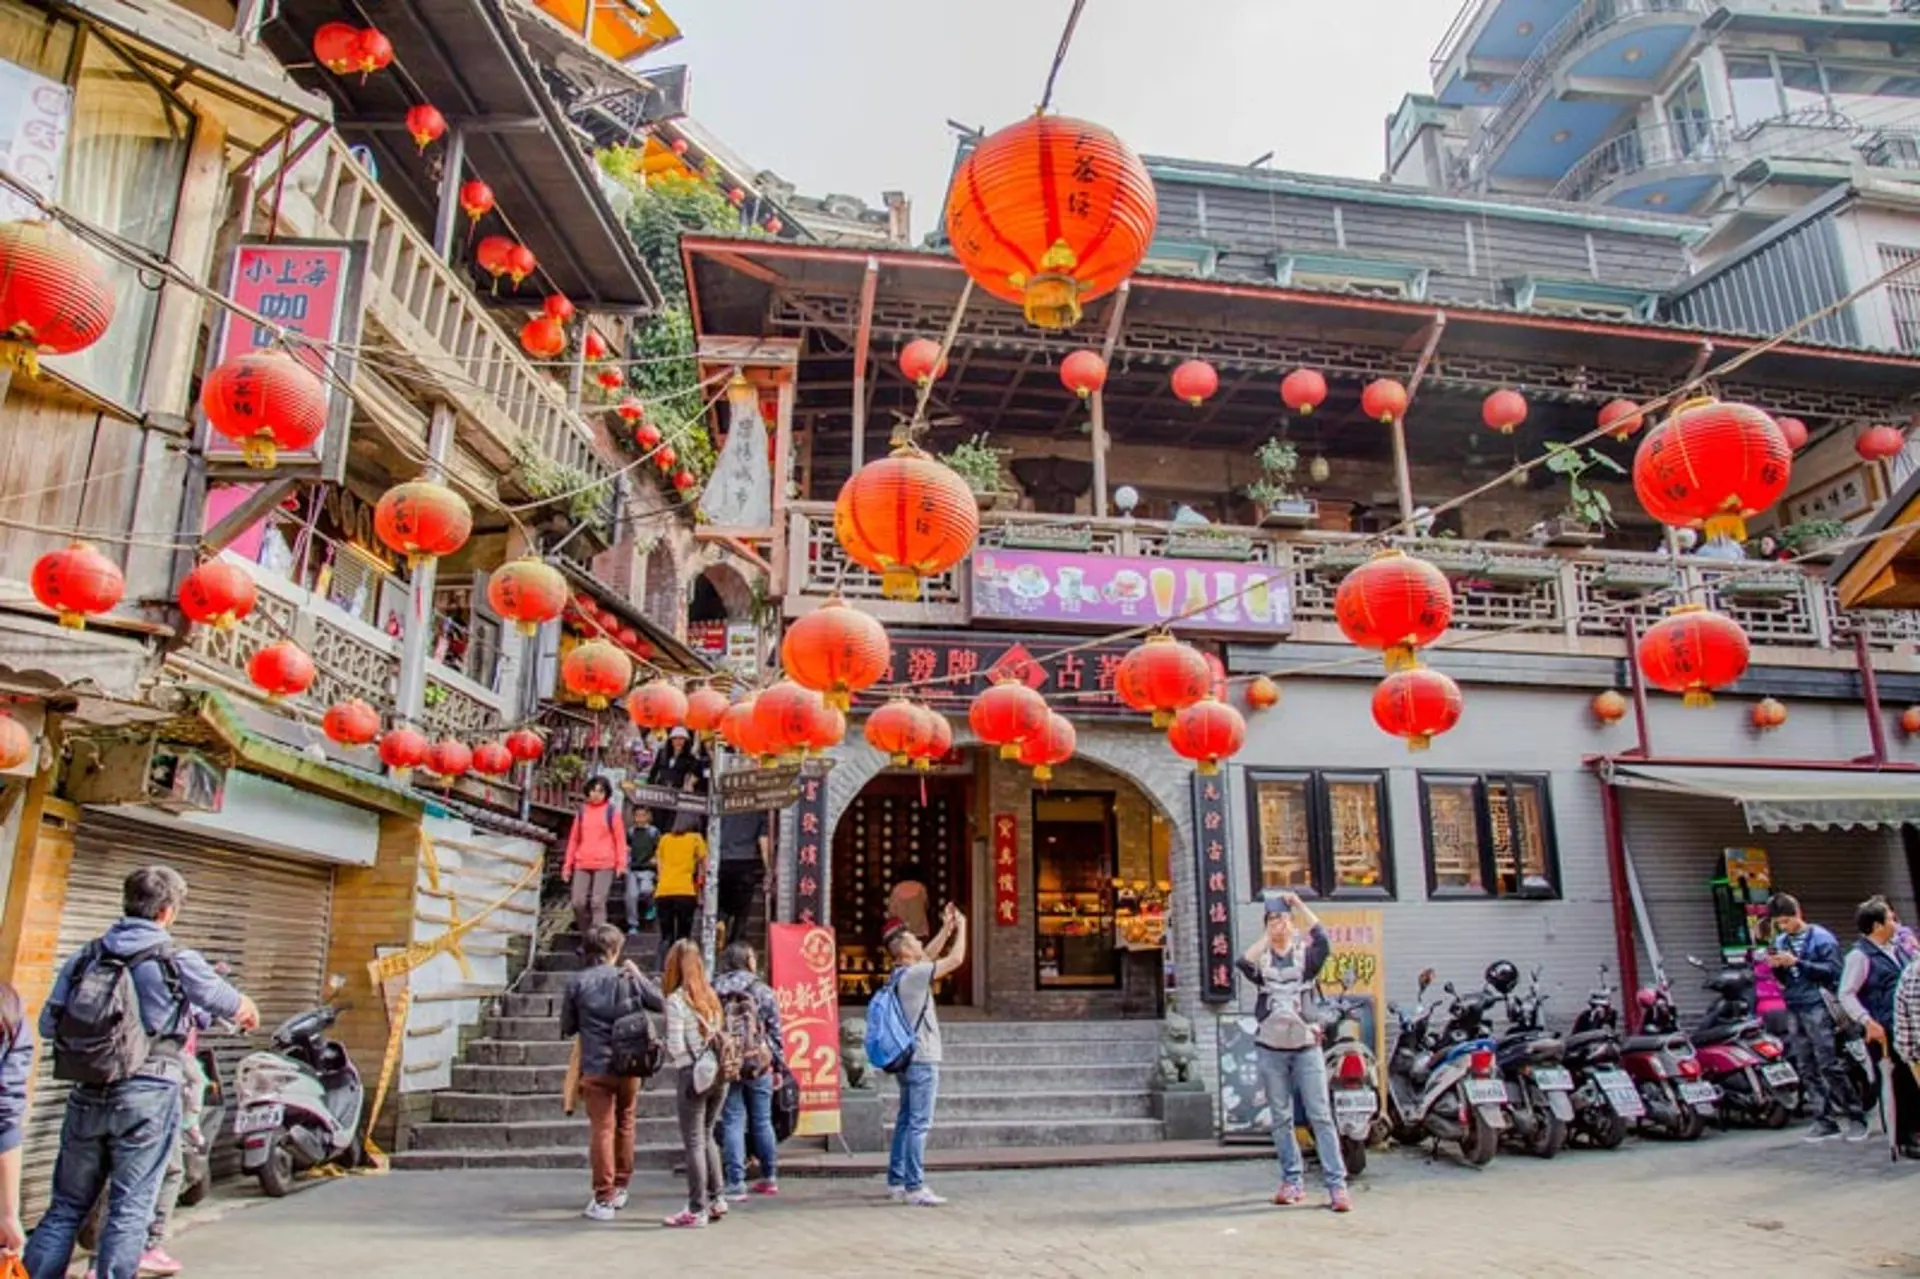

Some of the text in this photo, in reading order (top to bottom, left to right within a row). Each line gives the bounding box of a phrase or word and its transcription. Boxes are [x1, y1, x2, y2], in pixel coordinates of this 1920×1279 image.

[246, 259, 329, 287] 小上海
[788, 1031, 812, 1069] 2
[814, 1046, 838, 1086] 2
